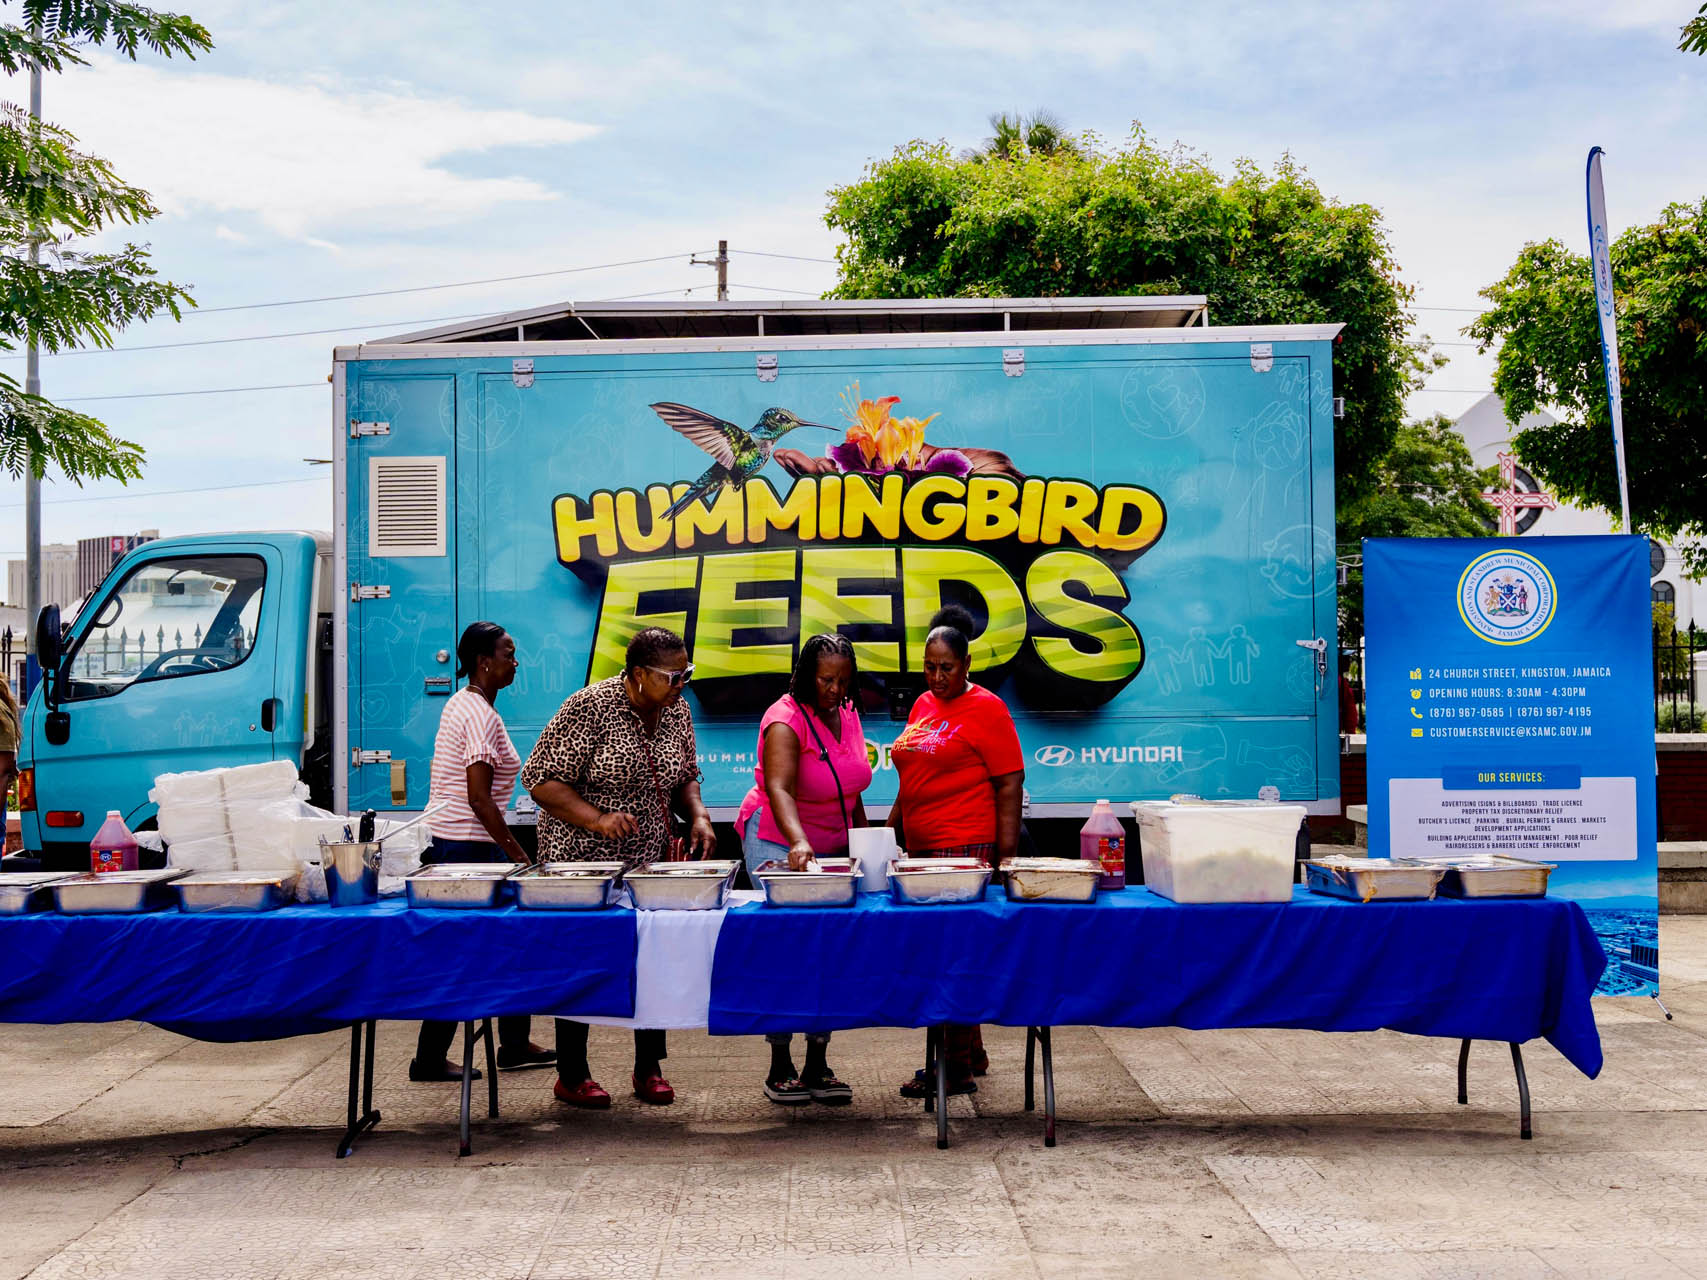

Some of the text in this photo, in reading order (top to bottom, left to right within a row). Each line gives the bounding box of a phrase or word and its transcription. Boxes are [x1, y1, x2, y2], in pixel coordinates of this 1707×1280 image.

[553, 474, 1166, 564] HUMMINGBIRD
[1475, 559, 1502, 576] ANDREW
[1504, 558, 1540, 576] MUNICIPAL
[1533, 578, 1548, 625] CORPORATION
[588, 547, 1143, 685] FEEDS
[1498, 627, 1530, 636] JAMAICA
[1429, 667, 1611, 679] 24 CHURCH STREET, KINGSTON, JAMAICA
[1429, 688, 1468, 698] OPENING
[1471, 688, 1504, 698] HOURS:
[1507, 687, 1542, 698] 8:30AM
[1551, 687, 1586, 697] 4:30PM
[1429, 708, 1456, 718] (876)
[1458, 707, 1504, 718] 967-0585
[1517, 707, 1543, 717] (876)
[1546, 706, 1592, 717] 967-4195
[1430, 726, 1592, 738] CUSTOMERSERVICE@KSAMC.GOV.JM
[1081, 746, 1183, 763] HYUNDAI
[1478, 772, 1545, 783] OUR SERVICES:
